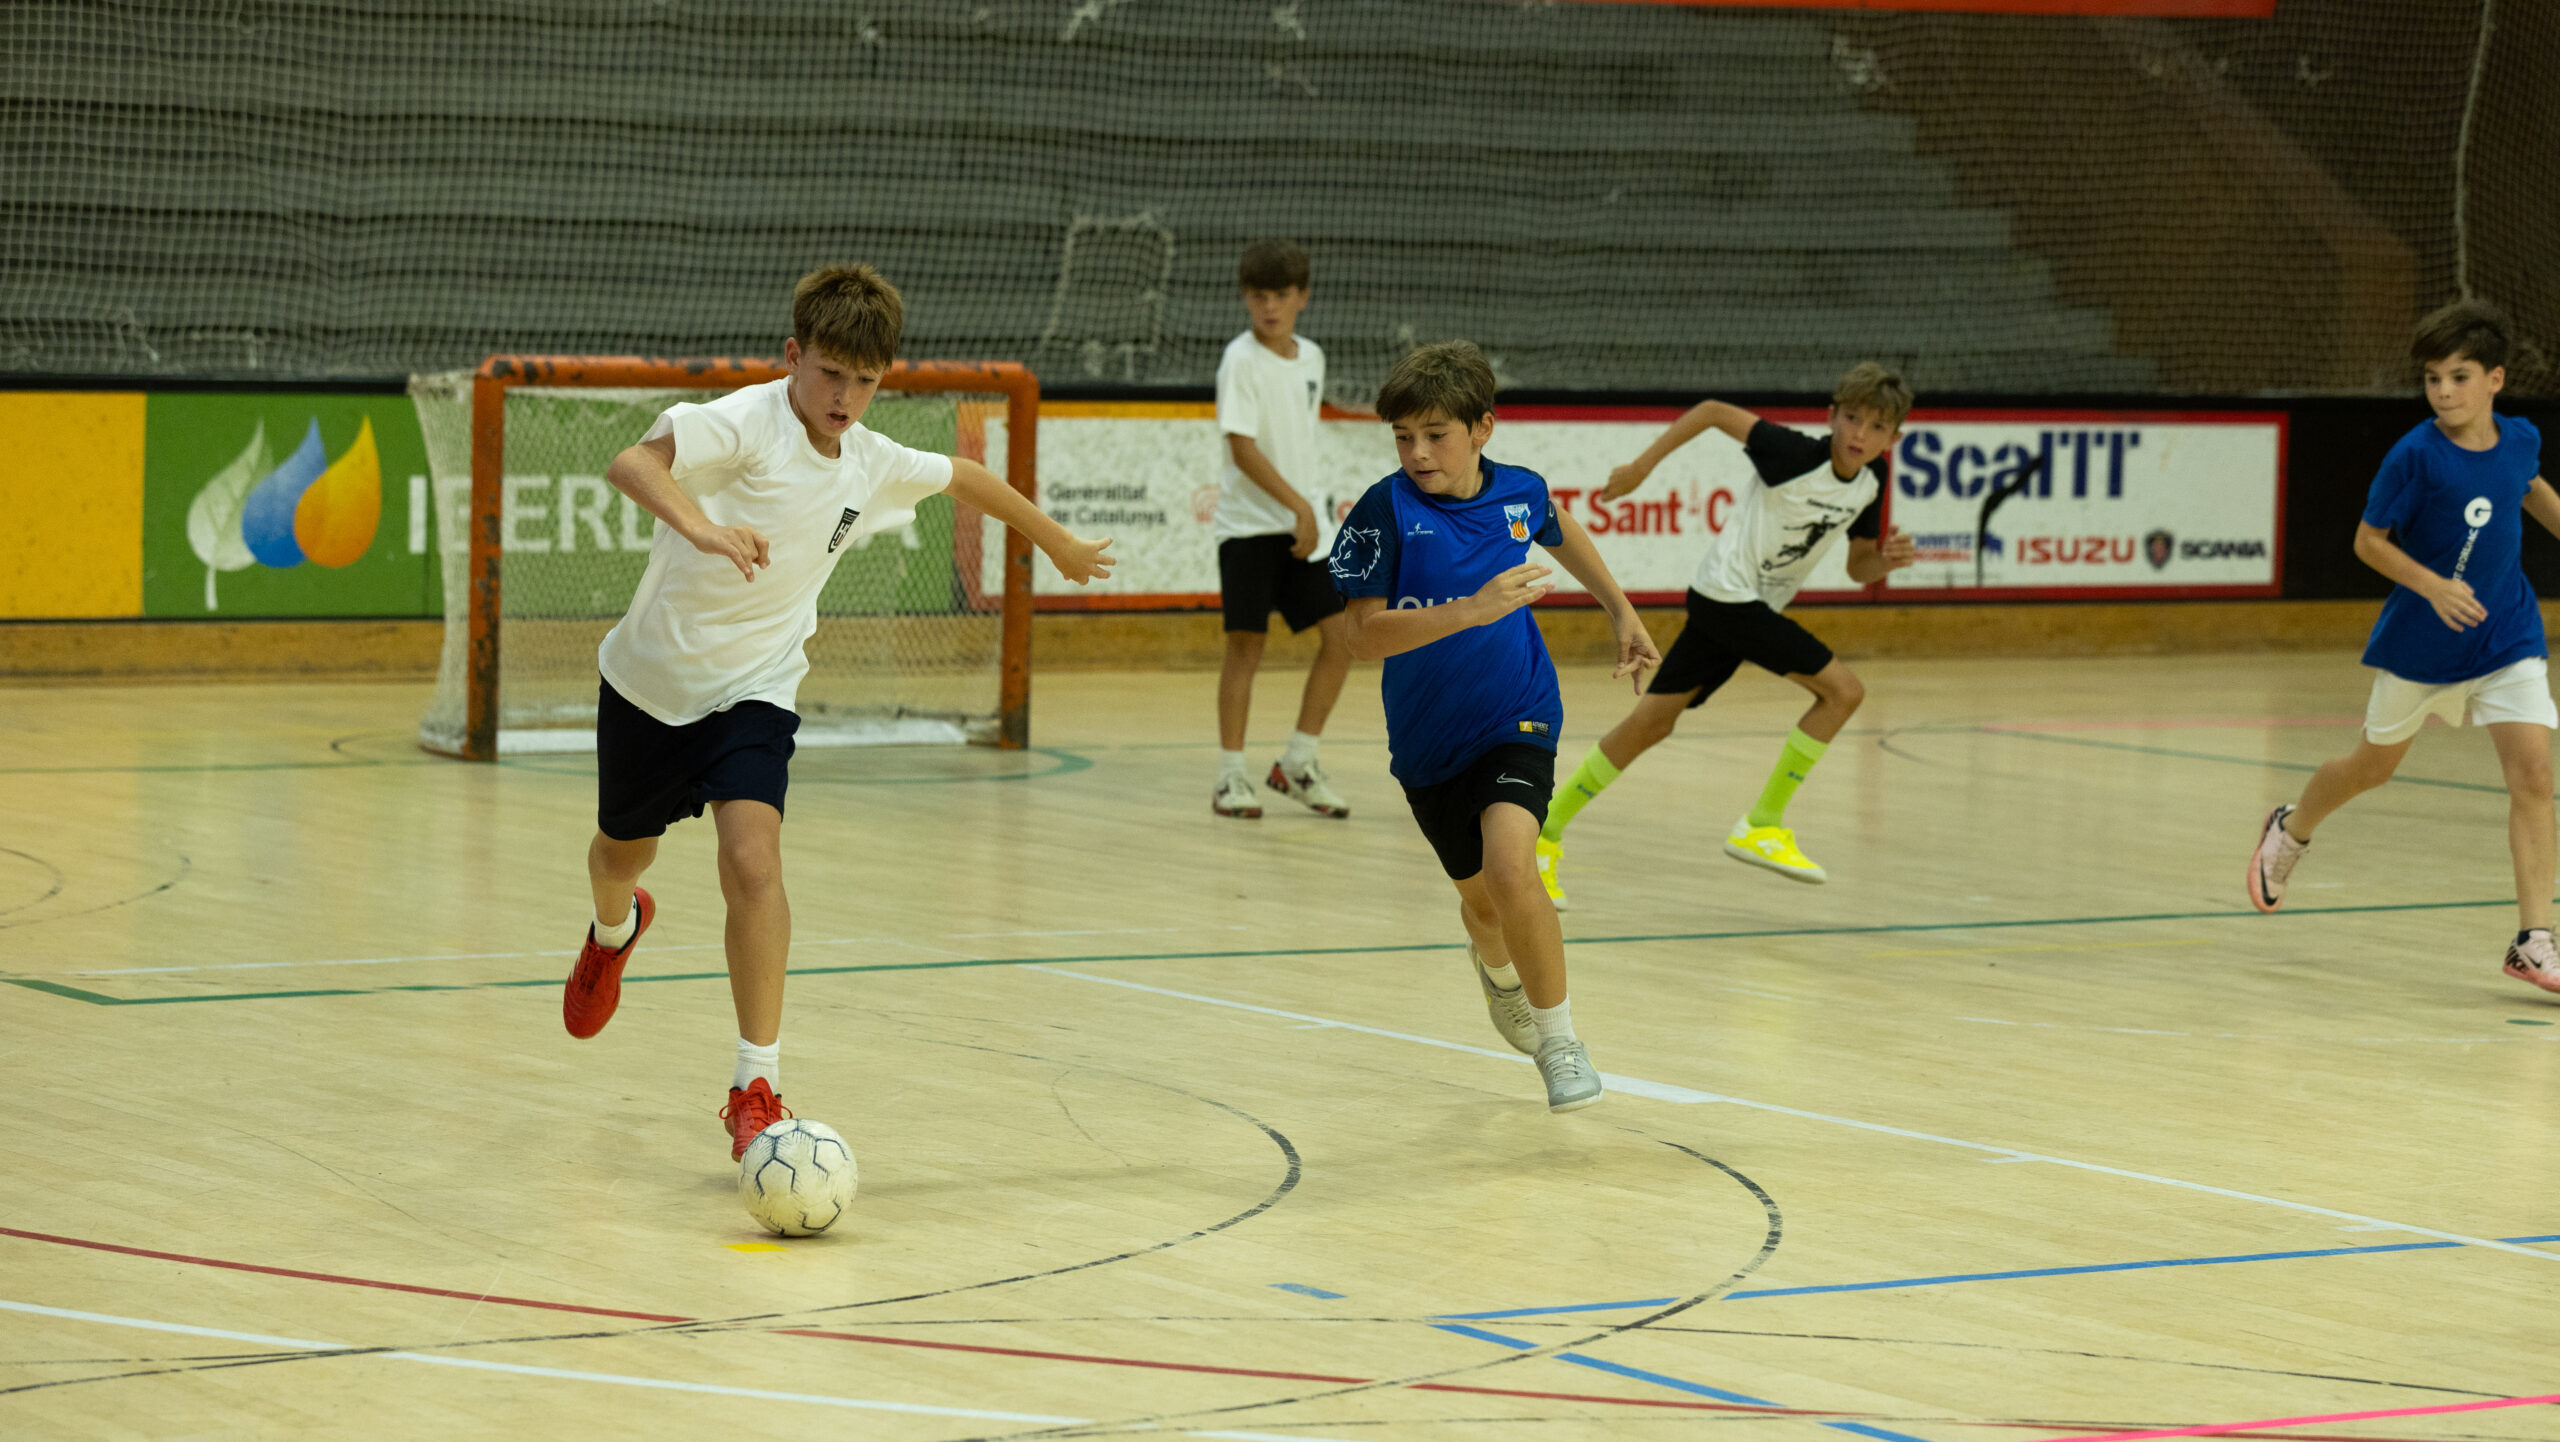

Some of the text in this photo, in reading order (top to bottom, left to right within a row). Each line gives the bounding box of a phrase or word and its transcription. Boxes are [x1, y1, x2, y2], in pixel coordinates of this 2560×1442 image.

[1047, 482, 1147, 502] Generalitat
[1075, 505, 1168, 532] Catalunya
[1588, 487, 1683, 536] Sant
[2017, 536, 2136, 565] ISUZU
[2180, 539, 2266, 560] SCANIA
